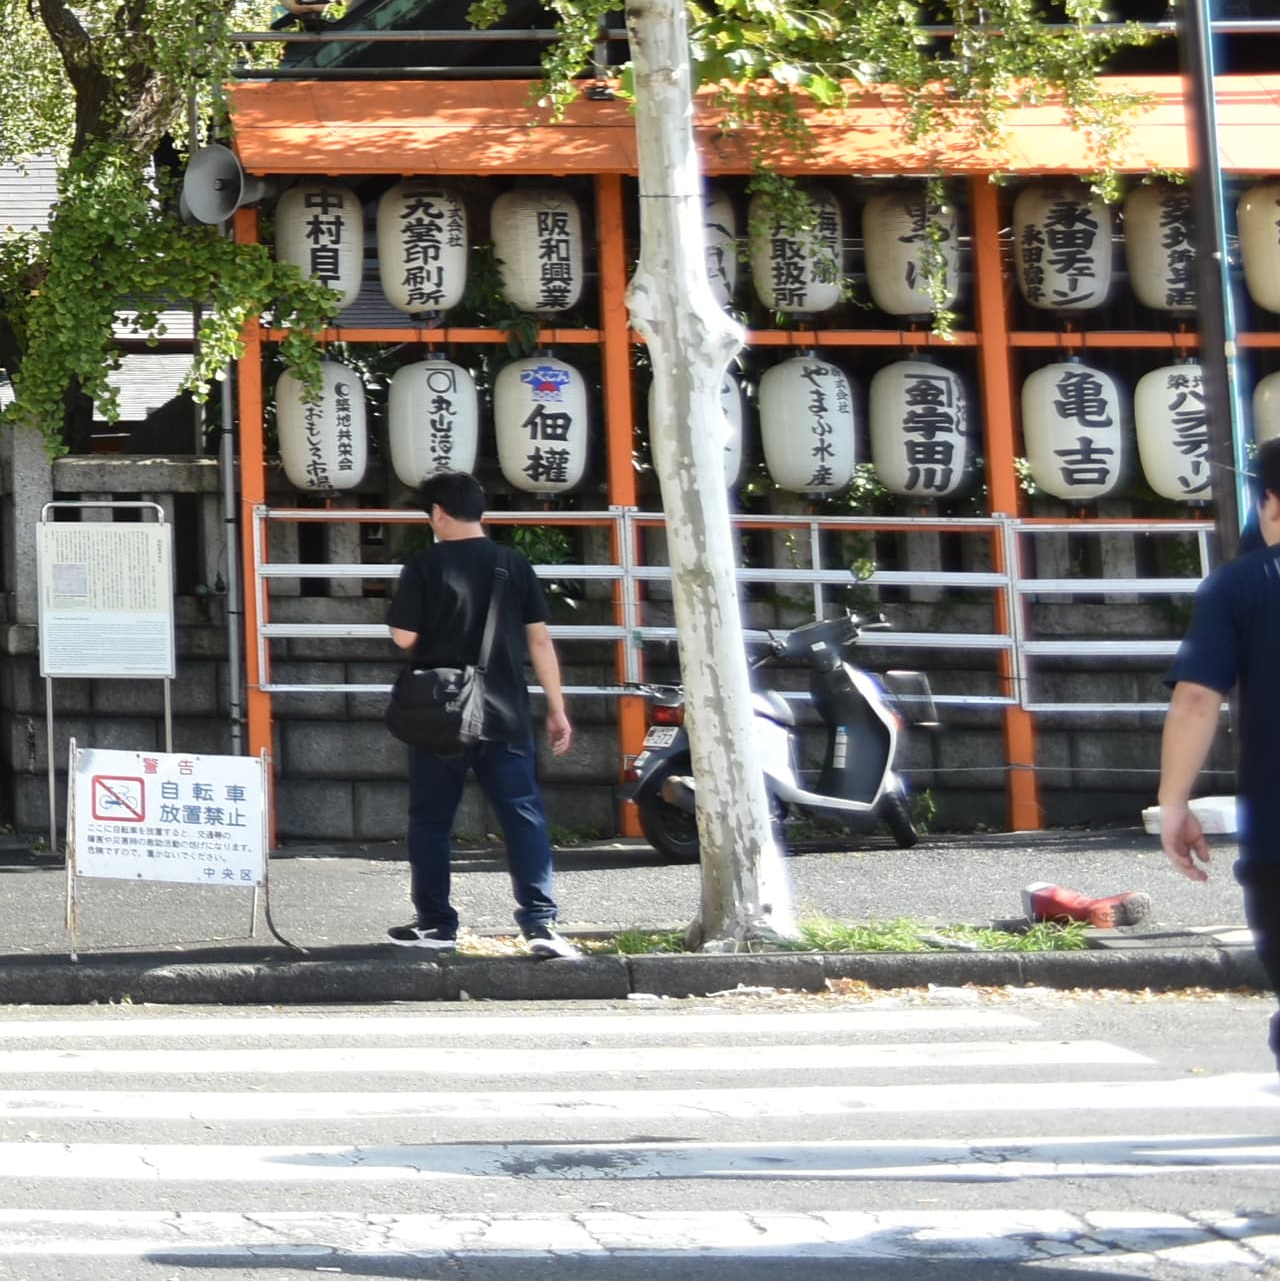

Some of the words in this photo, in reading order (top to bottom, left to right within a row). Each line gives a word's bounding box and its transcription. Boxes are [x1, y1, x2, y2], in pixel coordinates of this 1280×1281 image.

[400, 189, 446, 306] 一九堂印刷所
[536, 211, 574, 309] 阪和興業
[1052, 370, 1114, 488] 亀吉
[143, 757, 194, 776] 警告
[160, 780, 247, 804] 自転車
[159, 803, 247, 828] 放置禁止
[203, 867, 253, 881] 中央区
